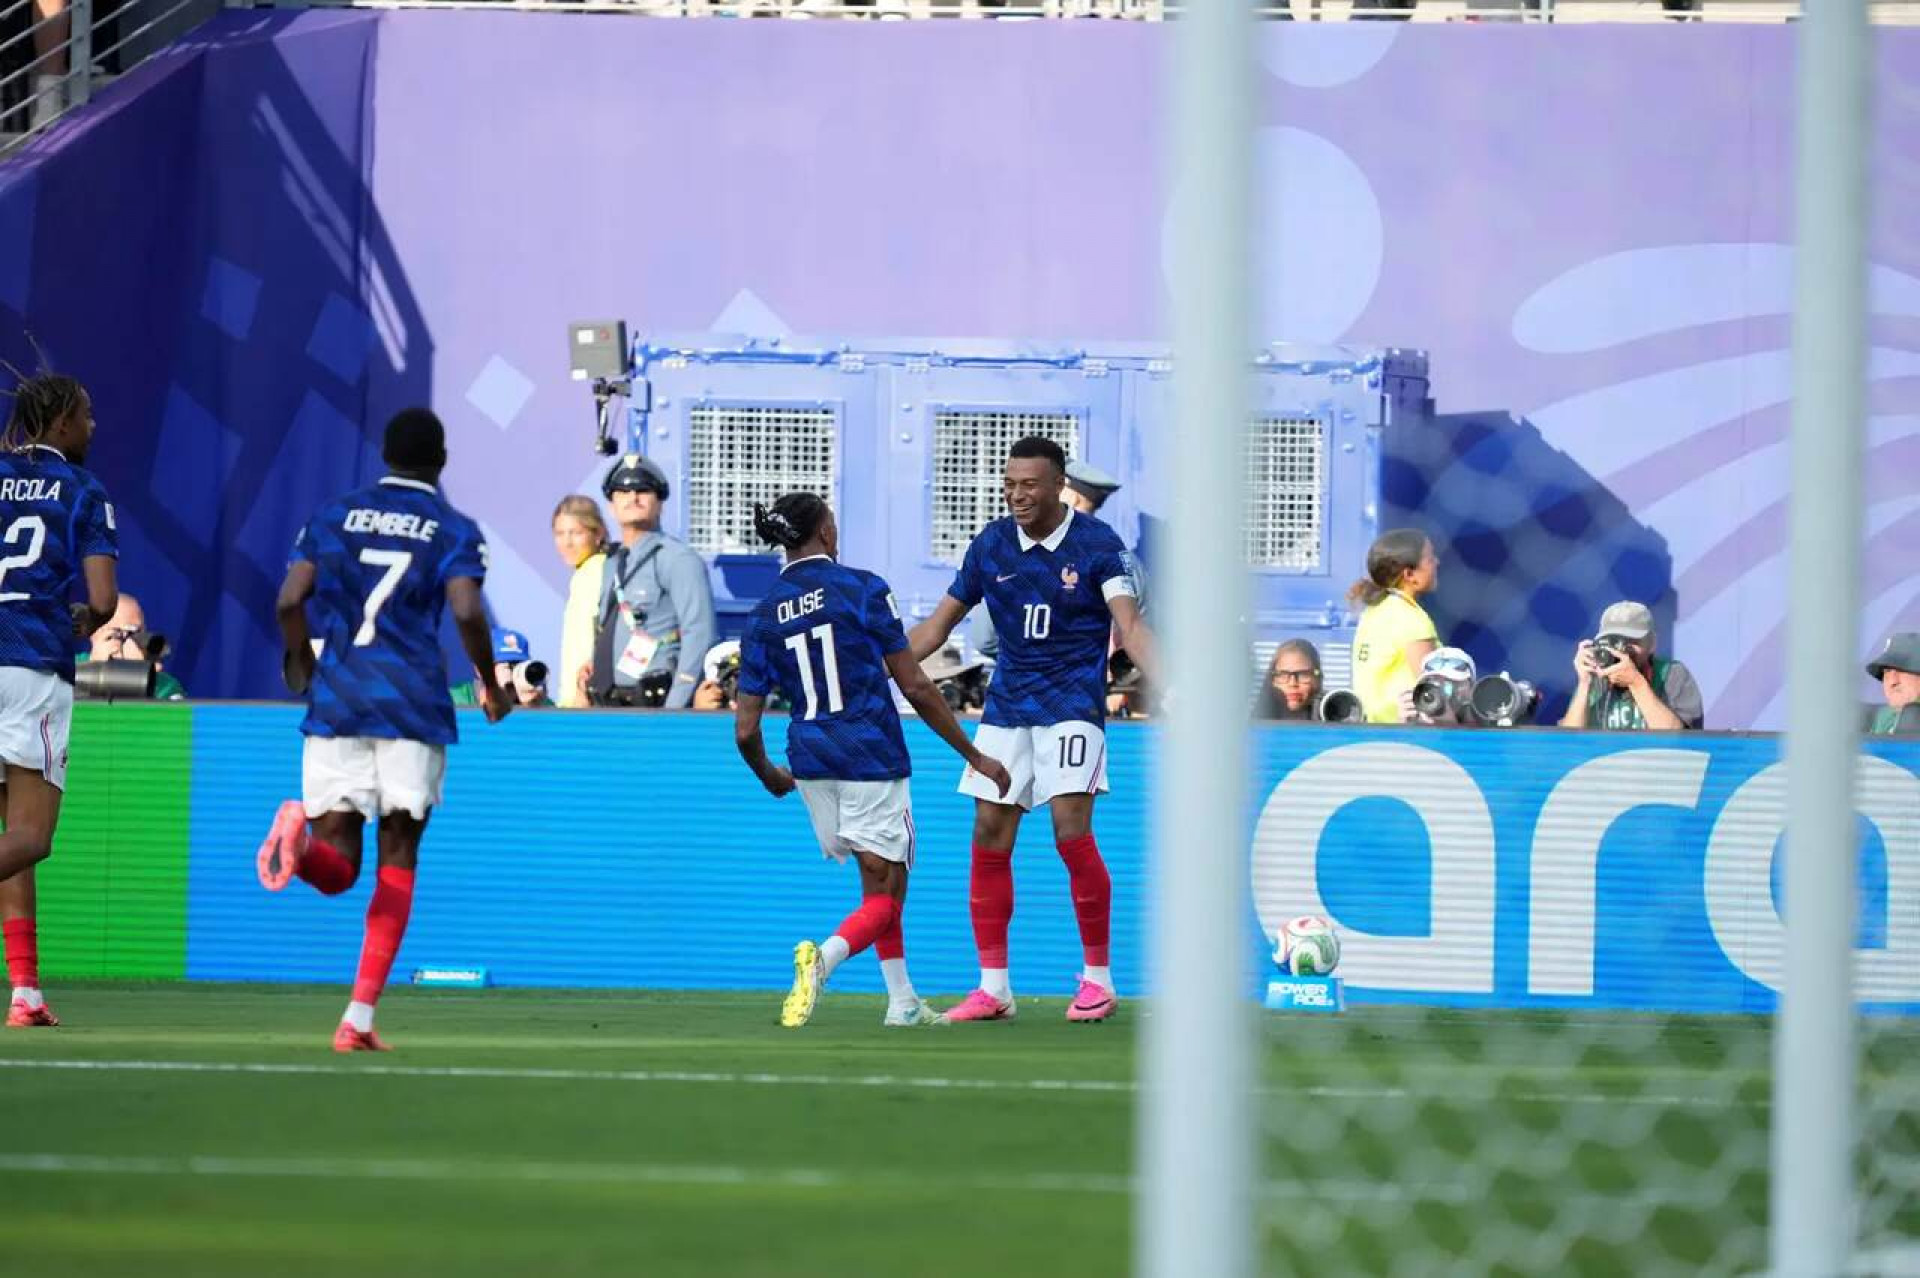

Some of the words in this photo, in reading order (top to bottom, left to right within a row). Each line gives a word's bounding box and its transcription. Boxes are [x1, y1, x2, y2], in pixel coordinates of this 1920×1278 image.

[343, 509, 438, 542] DEMBELE
[353, 548, 413, 645] 7
[777, 588, 825, 624] OLISE
[1023, 604, 1050, 640] 10
[784, 624, 843, 720] 11
[1059, 734, 1087, 768] 10
